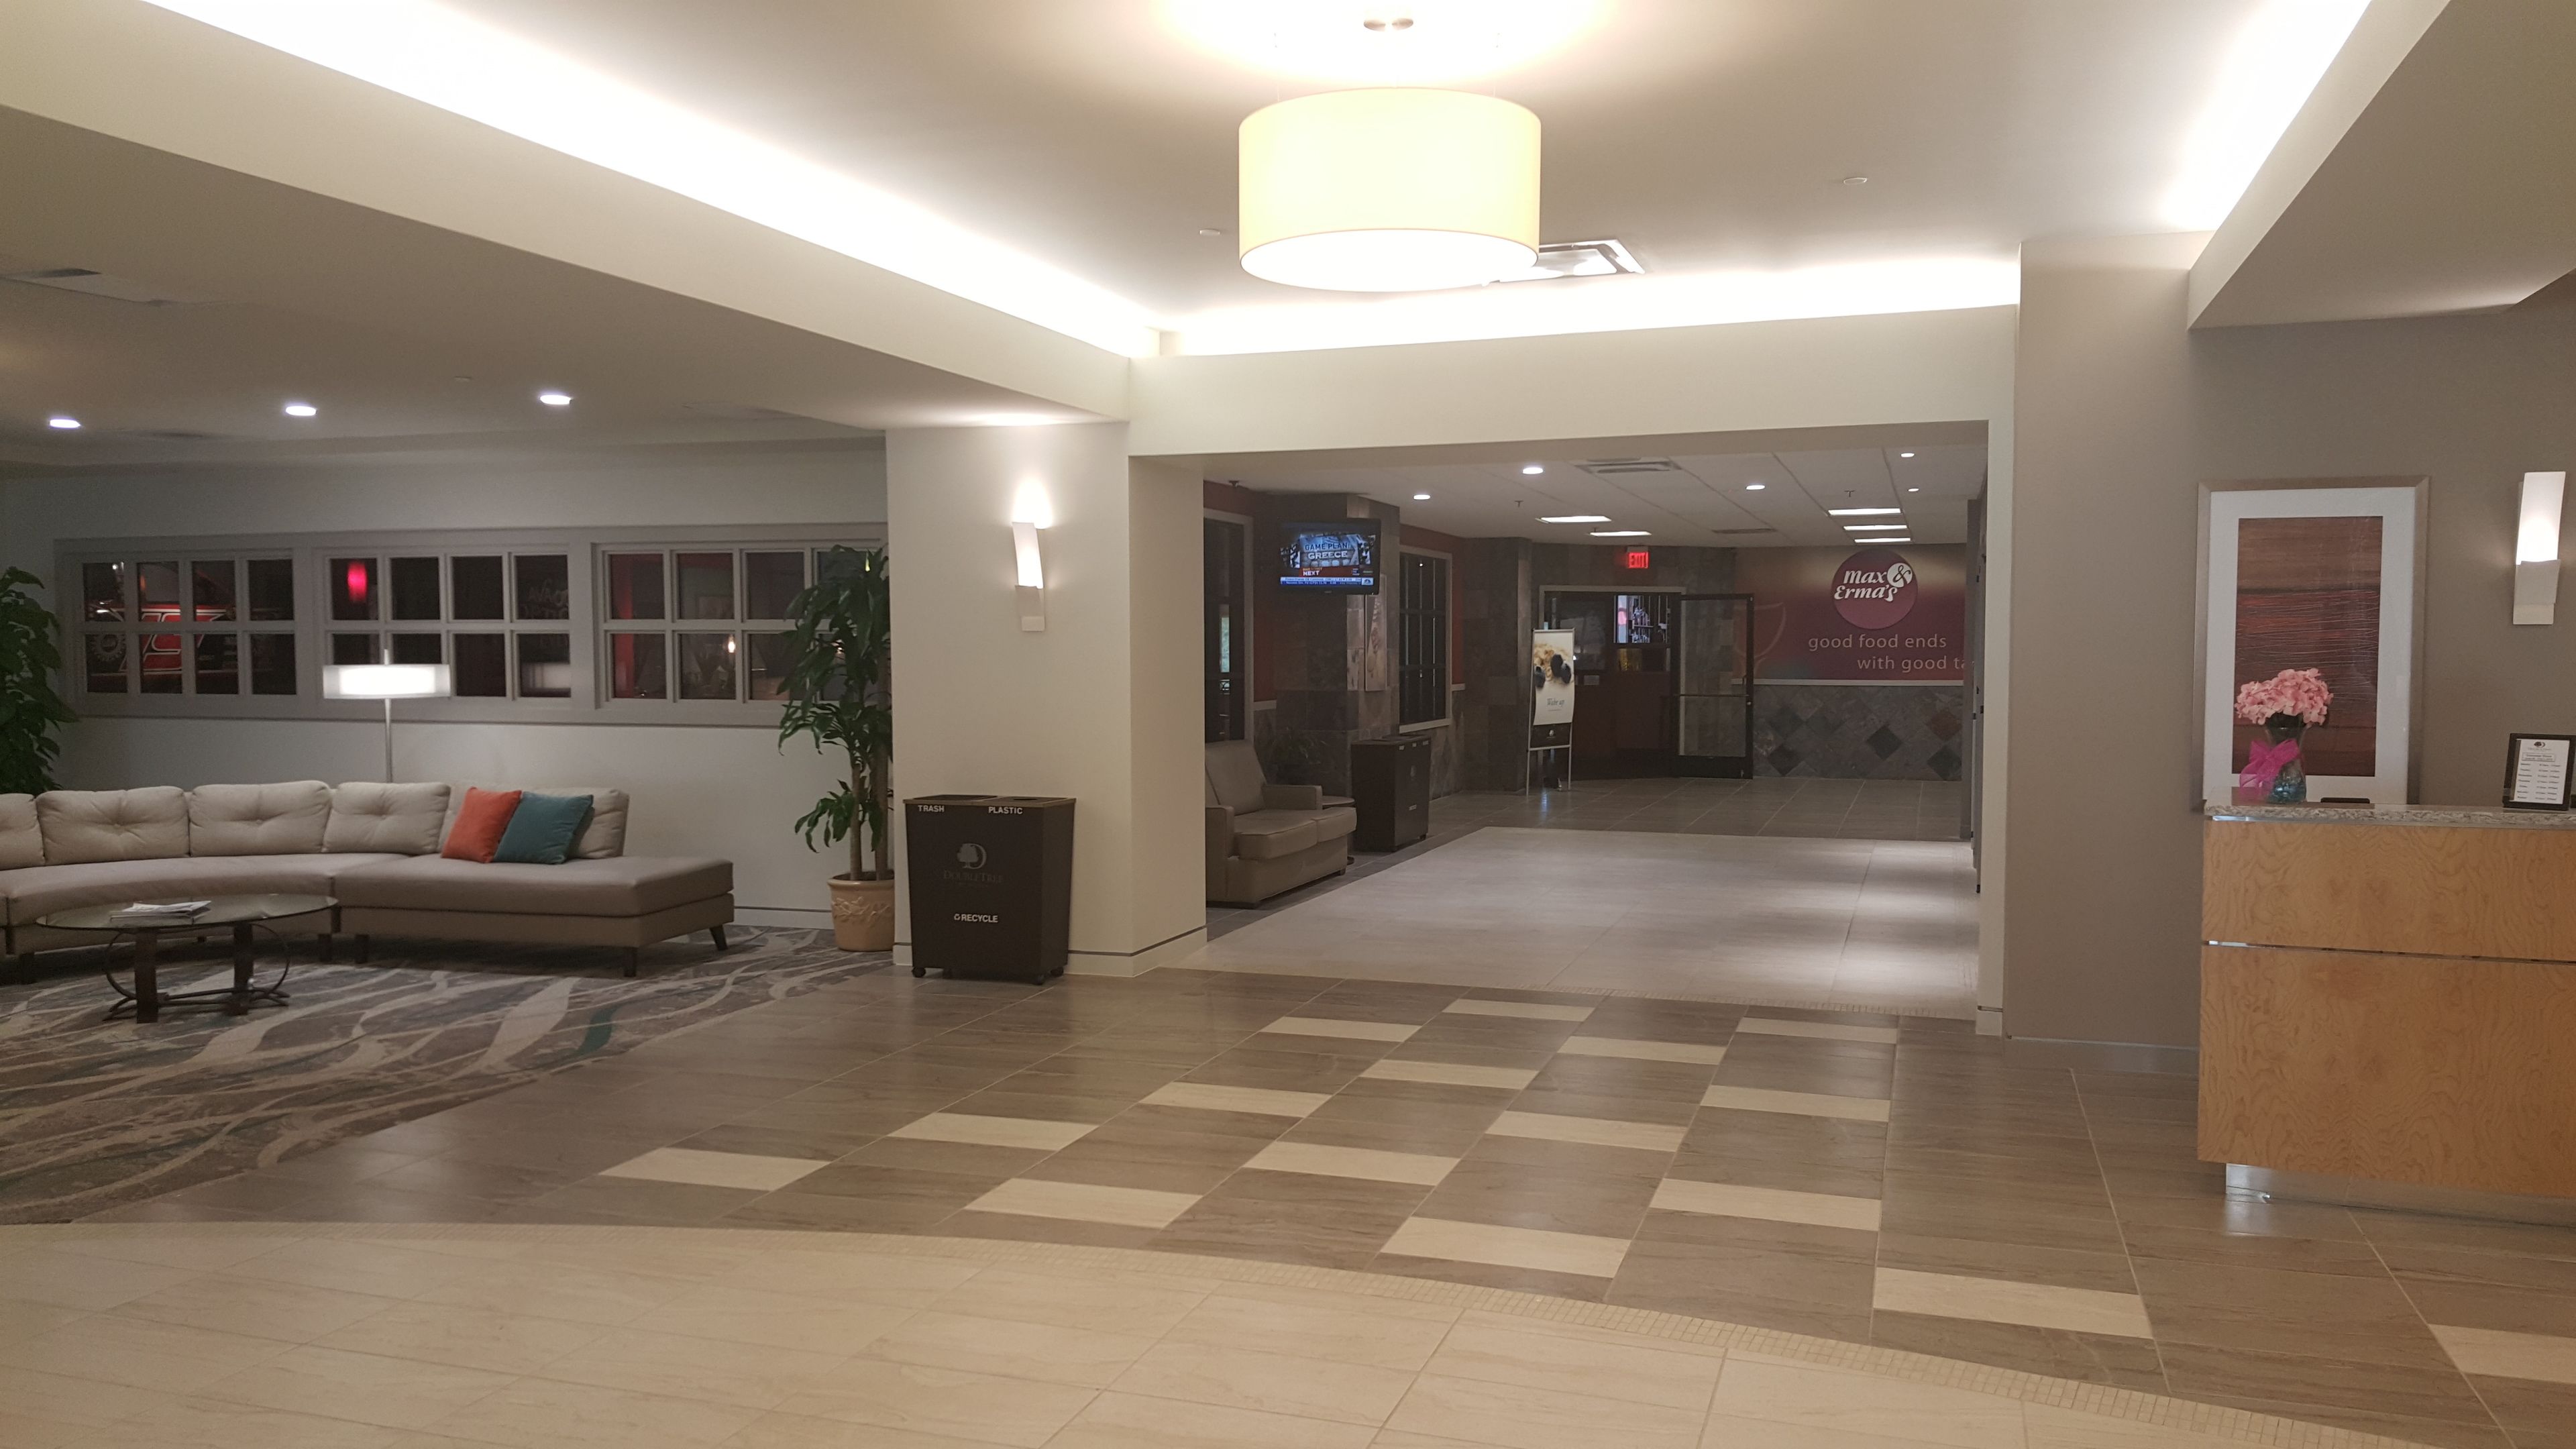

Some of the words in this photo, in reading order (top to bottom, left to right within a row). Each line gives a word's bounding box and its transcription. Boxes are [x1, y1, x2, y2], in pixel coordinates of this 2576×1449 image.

[1308, 551, 1348, 559] GREECE
[1843, 570, 1887, 584] Max
[1834, 584, 1898, 602] Erma's
[1809, 635, 1852, 651] good
[1859, 634, 1898, 648] food
[1904, 634, 1947, 648] ends
[1857, 655, 1894, 669] with
[1901, 655, 1946, 673] good
[988, 806, 1023, 814] PLASTIC
[961, 914, 998, 923] RECYCLE
